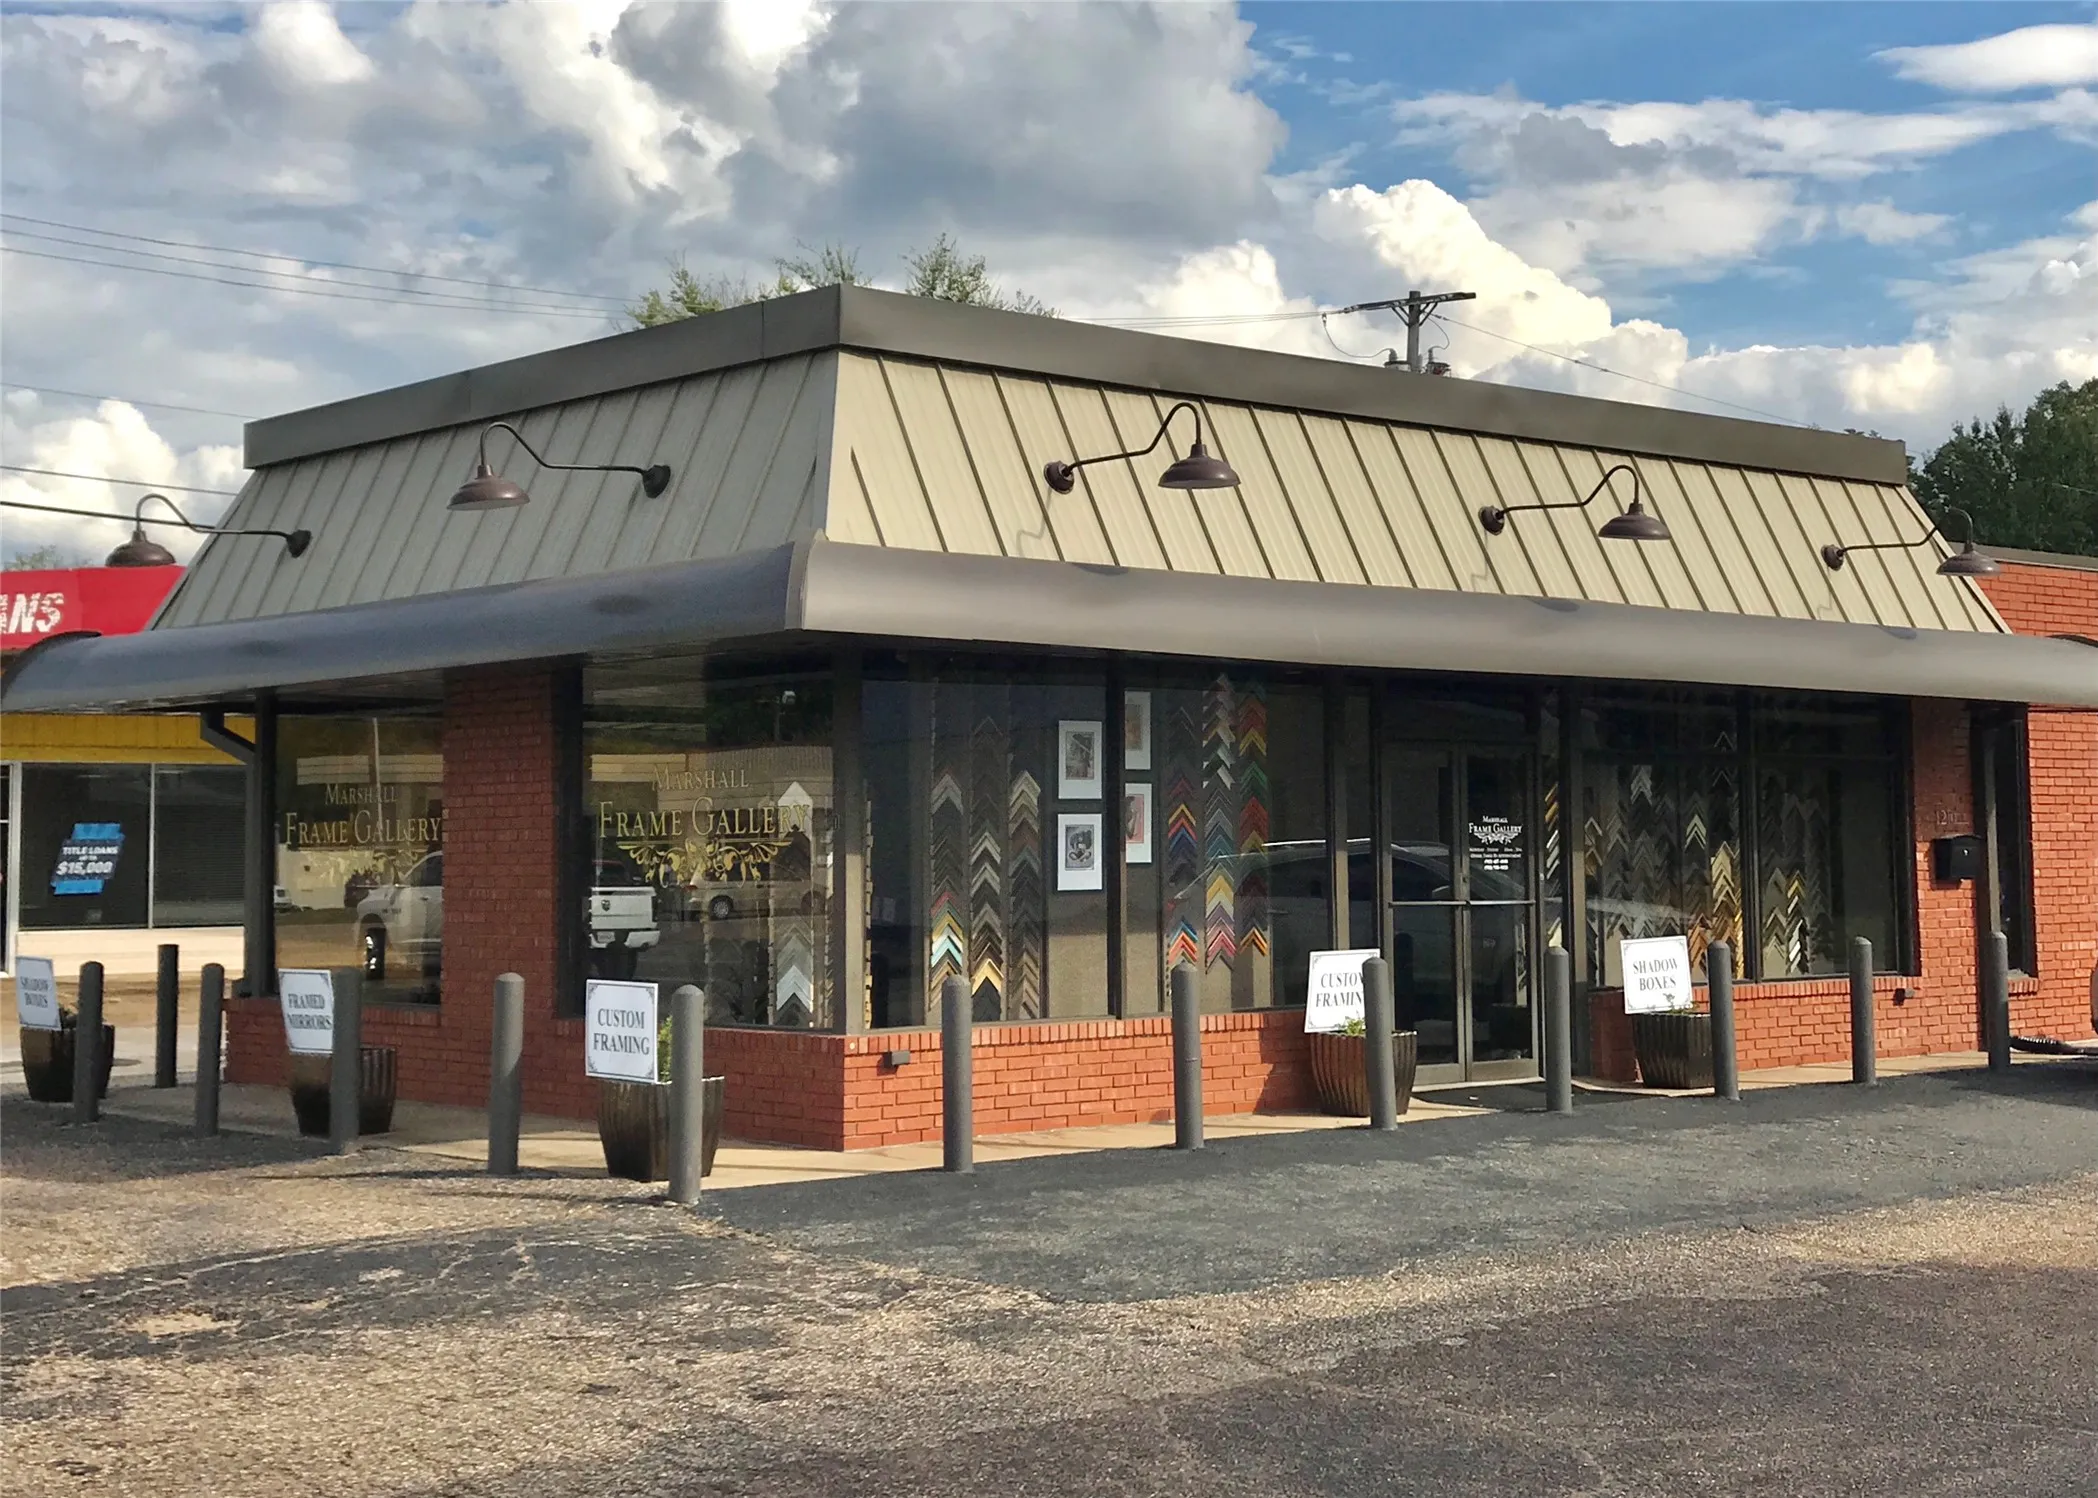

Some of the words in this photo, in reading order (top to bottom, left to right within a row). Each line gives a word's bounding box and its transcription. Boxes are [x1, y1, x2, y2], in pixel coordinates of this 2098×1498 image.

[285, 812, 349, 845] FRAME
[353, 809, 442, 845] GALLERY
[600, 801, 683, 839] FRAME
[691, 797, 812, 837] GALLERY
[1469, 822, 1492, 833] FRAME
[62, 846, 87, 855] TITLE
[88, 846, 119, 855] LOANS
[56, 861, 113, 875] $15,000
[1632, 957, 1679, 975] SHADOW
[1639, 975, 1677, 992] BOXES
[287, 993, 326, 1011] FRAMED
[1315, 991, 1363, 1009] FRAMIN
[597, 1007, 646, 1030] CUSTOM
[592, 1032, 651, 1056] FRAMING
